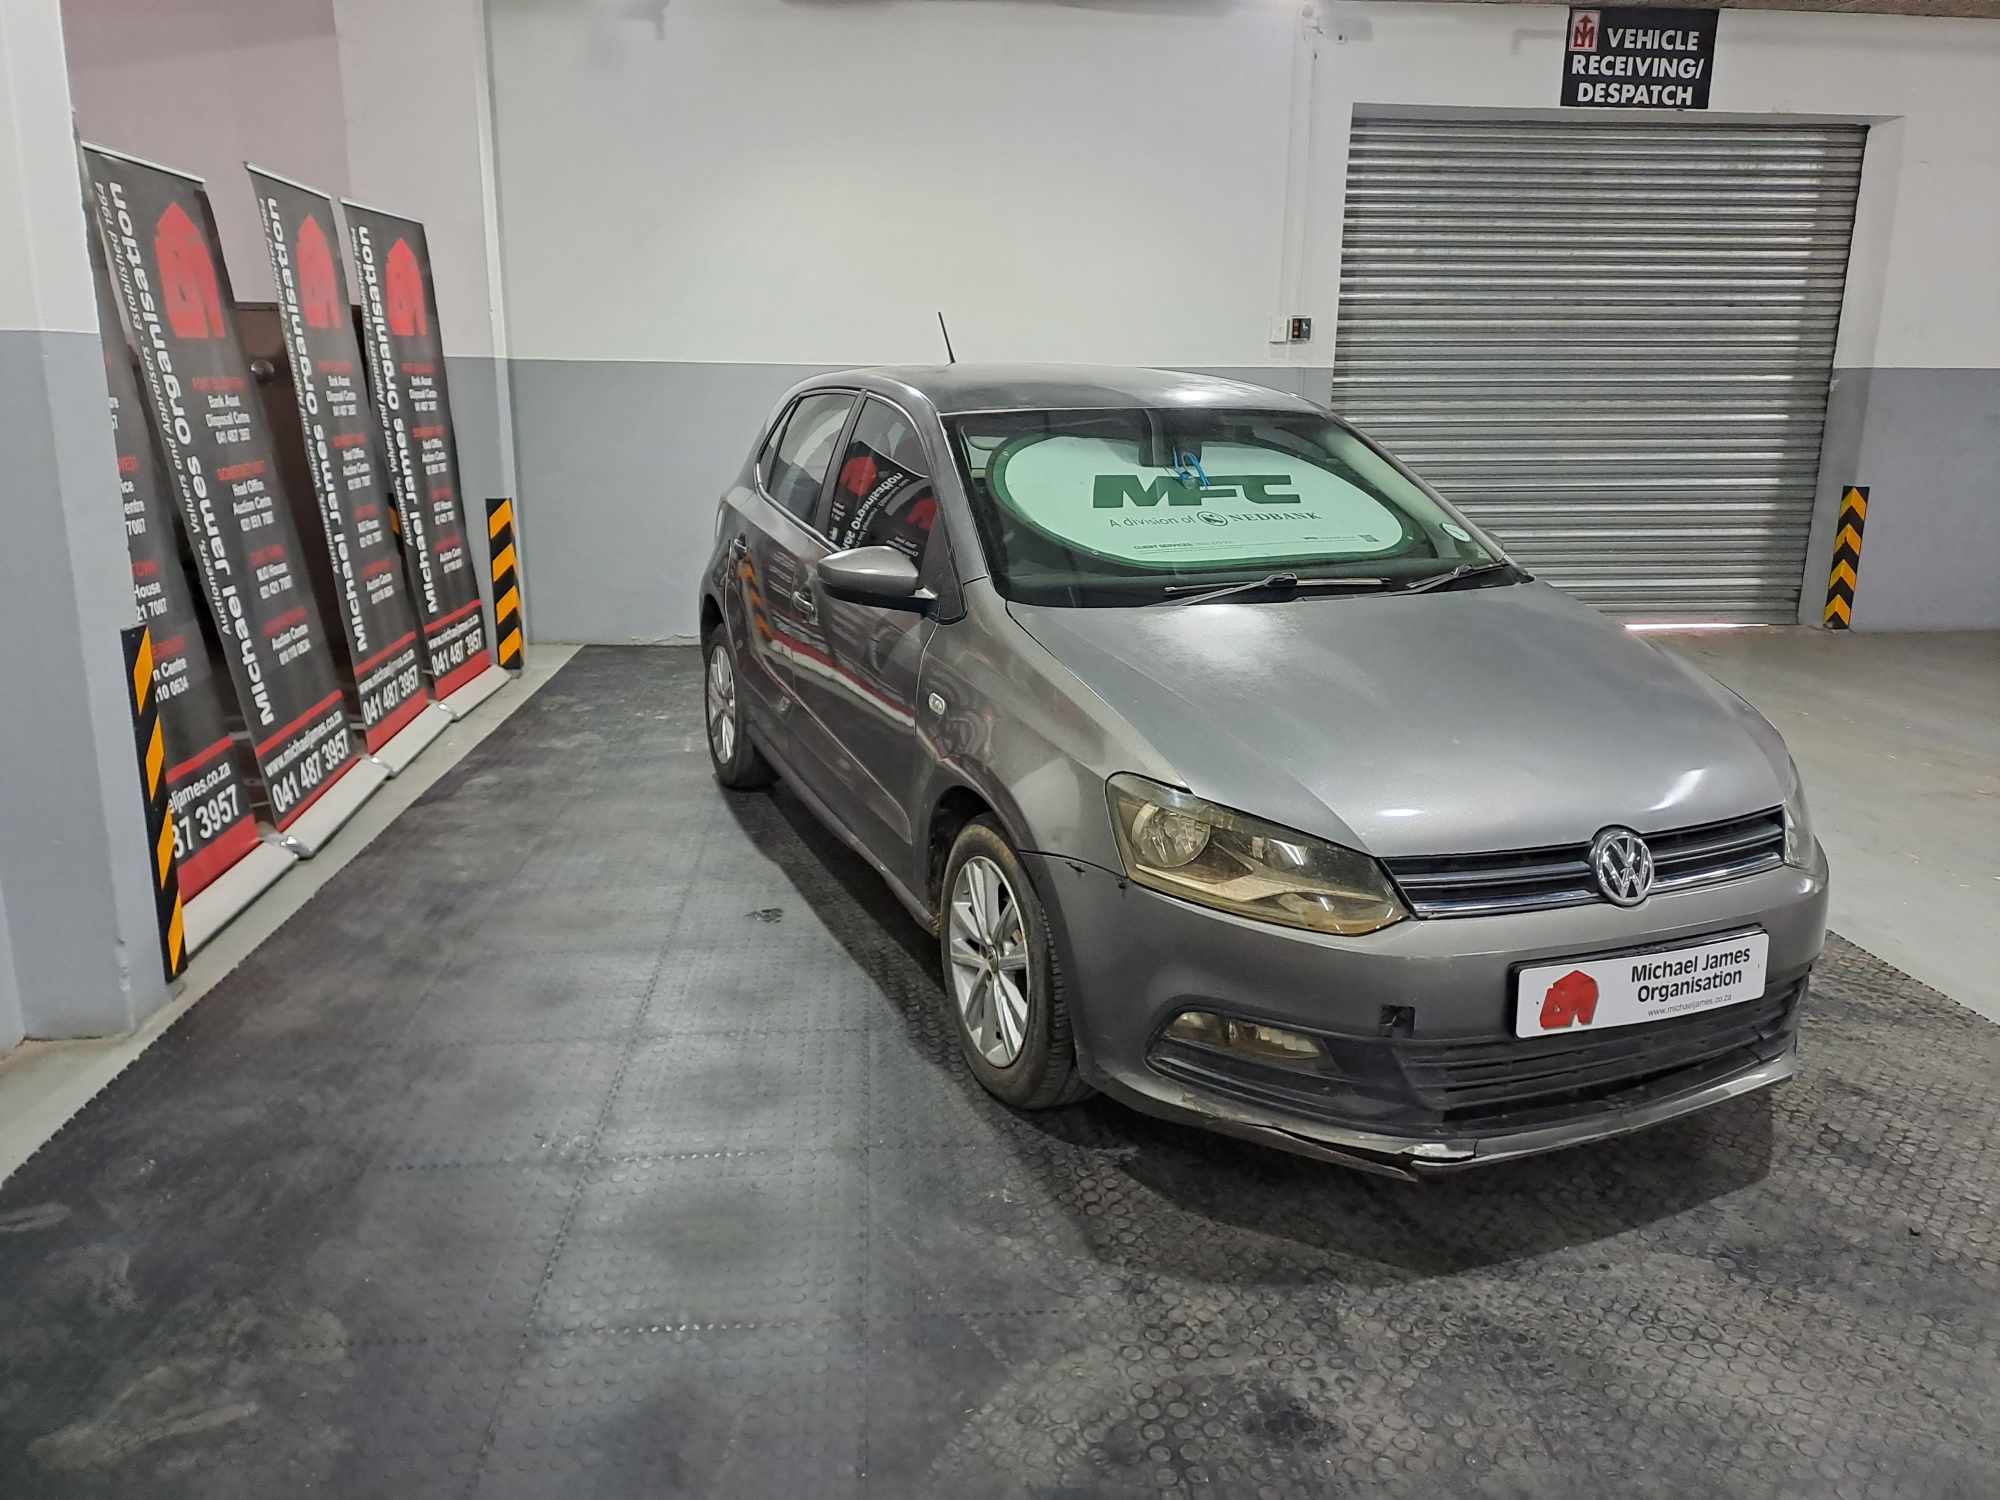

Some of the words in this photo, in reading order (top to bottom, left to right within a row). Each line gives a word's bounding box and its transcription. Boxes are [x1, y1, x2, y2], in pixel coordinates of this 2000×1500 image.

[1571, 55, 1705, 79] RECEIVING/
[1607, 28, 1700, 51] VEHICLE
[1577, 82, 1693, 106] DESPATCH
[109, 182, 192, 445] Organisation
[267, 197, 319, 416] Organisation
[358, 226, 400, 411] Organisation
[141, 346, 174, 435] Appraisers
[166, 437, 183, 470] and
[313, 424, 342, 525] James
[393, 418, 418, 504] James
[178, 473, 201, 533] Valuers
[186, 455, 231, 576] James
[1093, 474, 1301, 508] MFC
[1109, 518, 1122, 528] A
[1123, 516, 1177, 527] division
[1181, 514, 1195, 524] of
[1226, 511, 1322, 522] NEDBANK
[334, 533, 368, 653] Michael
[409, 511, 439, 614] Michael
[222, 585, 275, 726] Michael
[431, 649, 451, 677] 041
[449, 640, 464, 665] 487
[464, 628, 482, 656] 3957
[362, 692, 384, 726] 041
[383, 679, 399, 710] 487
[398, 664, 419, 698] 3957
[272, 771, 301, 813] 041
[300, 753, 323, 789] 487
[321, 728, 351, 771] 3957
[195, 783, 240, 840] 3957
[1631, 956, 1698, 983] Michael
[1702, 948, 1751, 971] James
[1637, 969, 1742, 1002] Organisation
